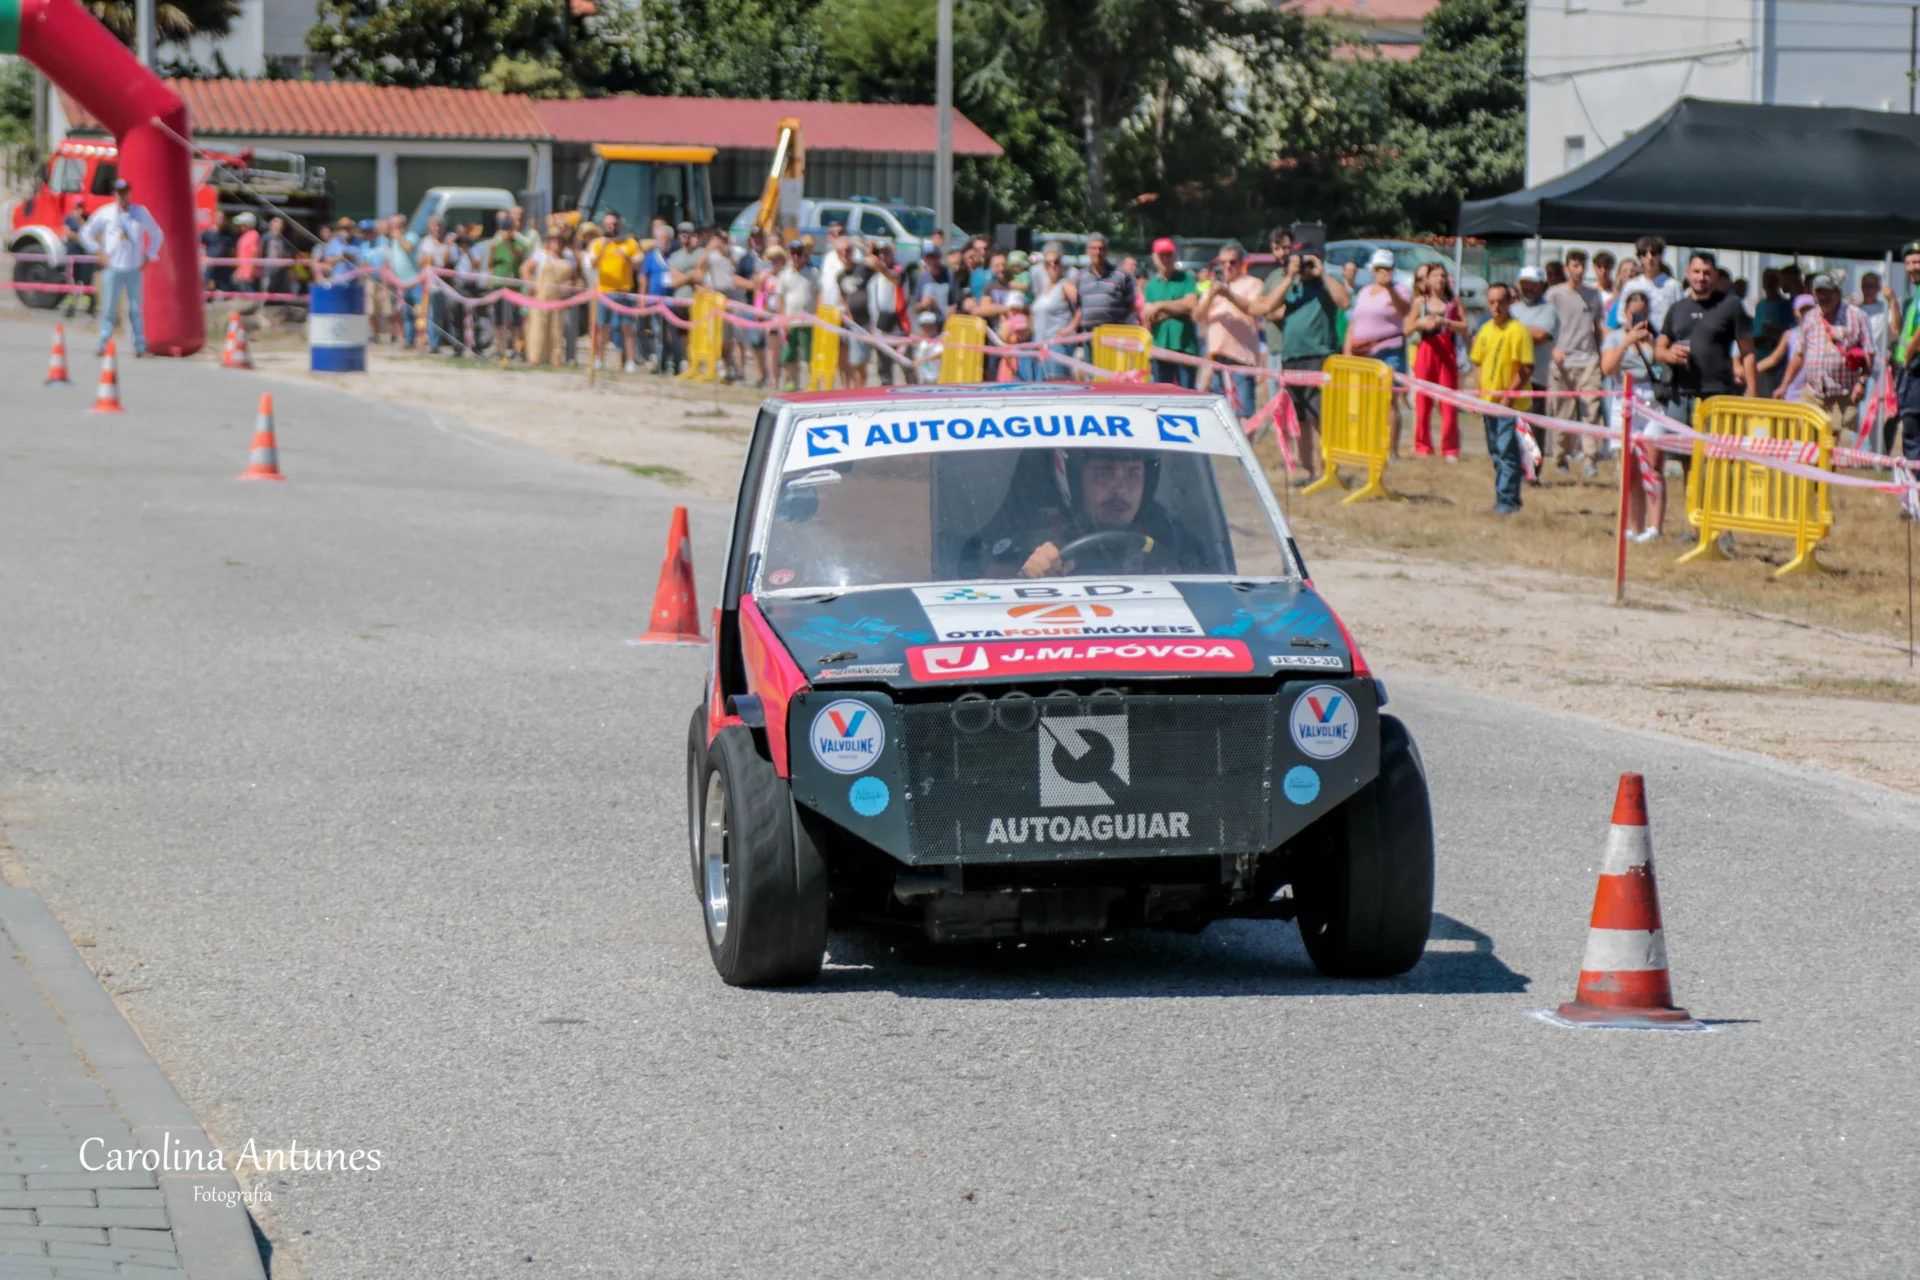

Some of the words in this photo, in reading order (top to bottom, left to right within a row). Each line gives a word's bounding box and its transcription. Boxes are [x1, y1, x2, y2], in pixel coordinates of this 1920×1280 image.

[865, 415, 1134, 446] AUTOAGUIAR
[1013, 584, 1154, 598] B.D.
[1000, 644, 1236, 662] J.M.PÓVOA
[1274, 656, 1340, 666] JE-63-30
[1299, 723, 1349, 739] VALVOLINE
[820, 737, 874, 754] VALVOLINE
[986, 812, 1190, 843] AUTOAGUIAR
